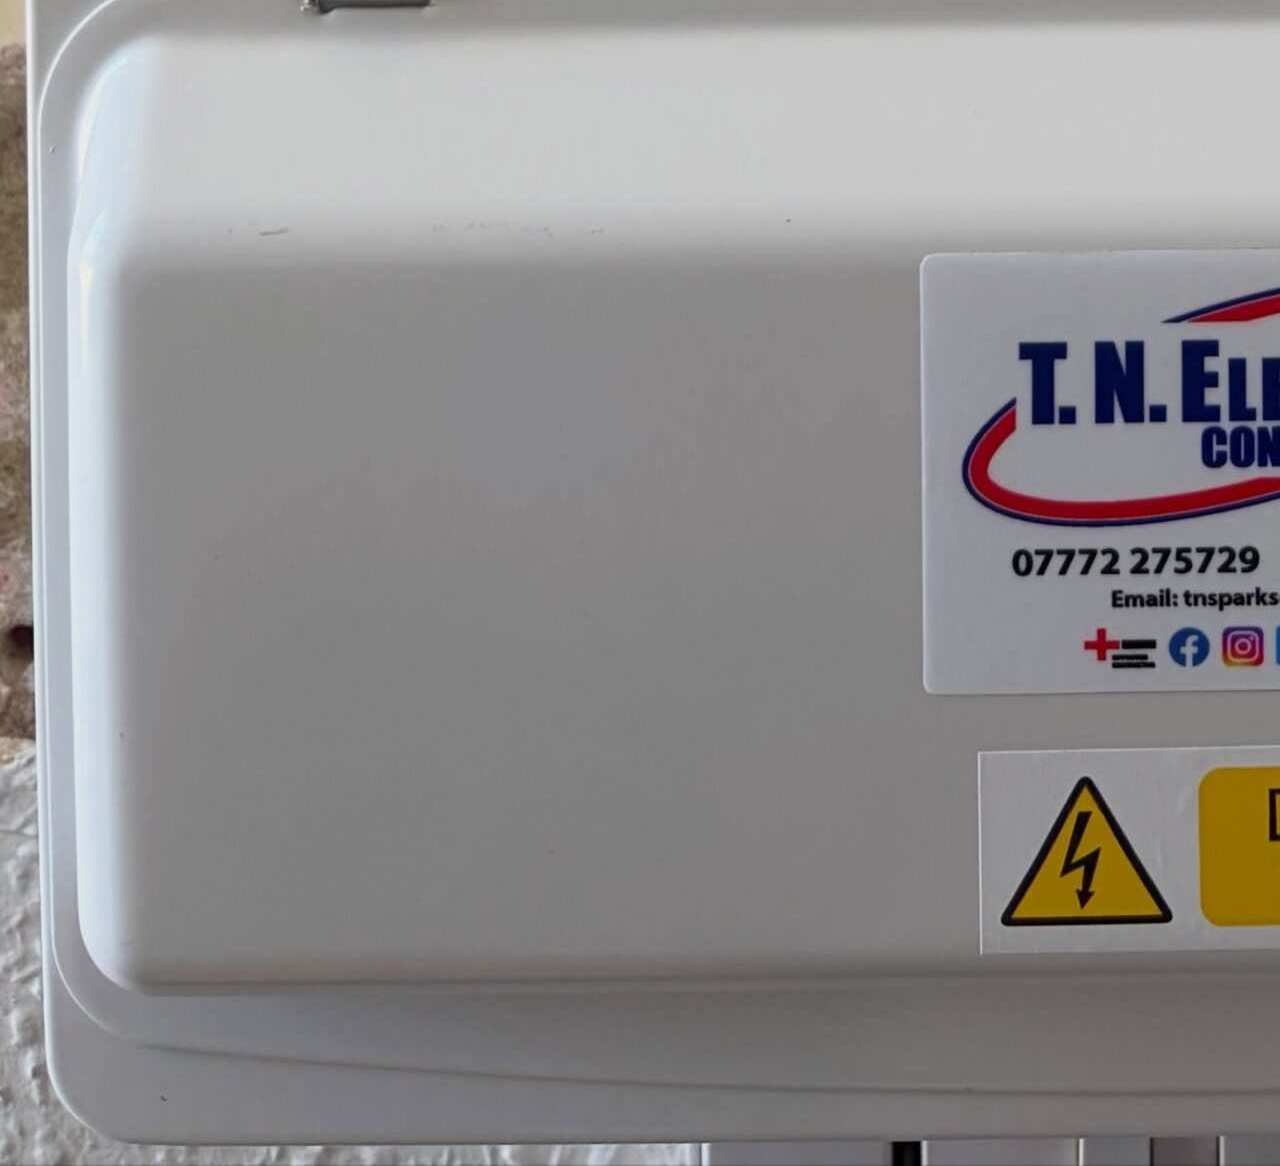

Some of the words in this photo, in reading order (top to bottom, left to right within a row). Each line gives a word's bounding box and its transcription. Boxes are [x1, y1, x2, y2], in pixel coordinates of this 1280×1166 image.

[1018, 340, 1077, 425] T.
[1094, 340, 1167, 424] N.
[1012, 547, 1121, 577] 07772
[1130, 545, 1261, 575] 275729
[1111, 588, 1179, 609] Email:
